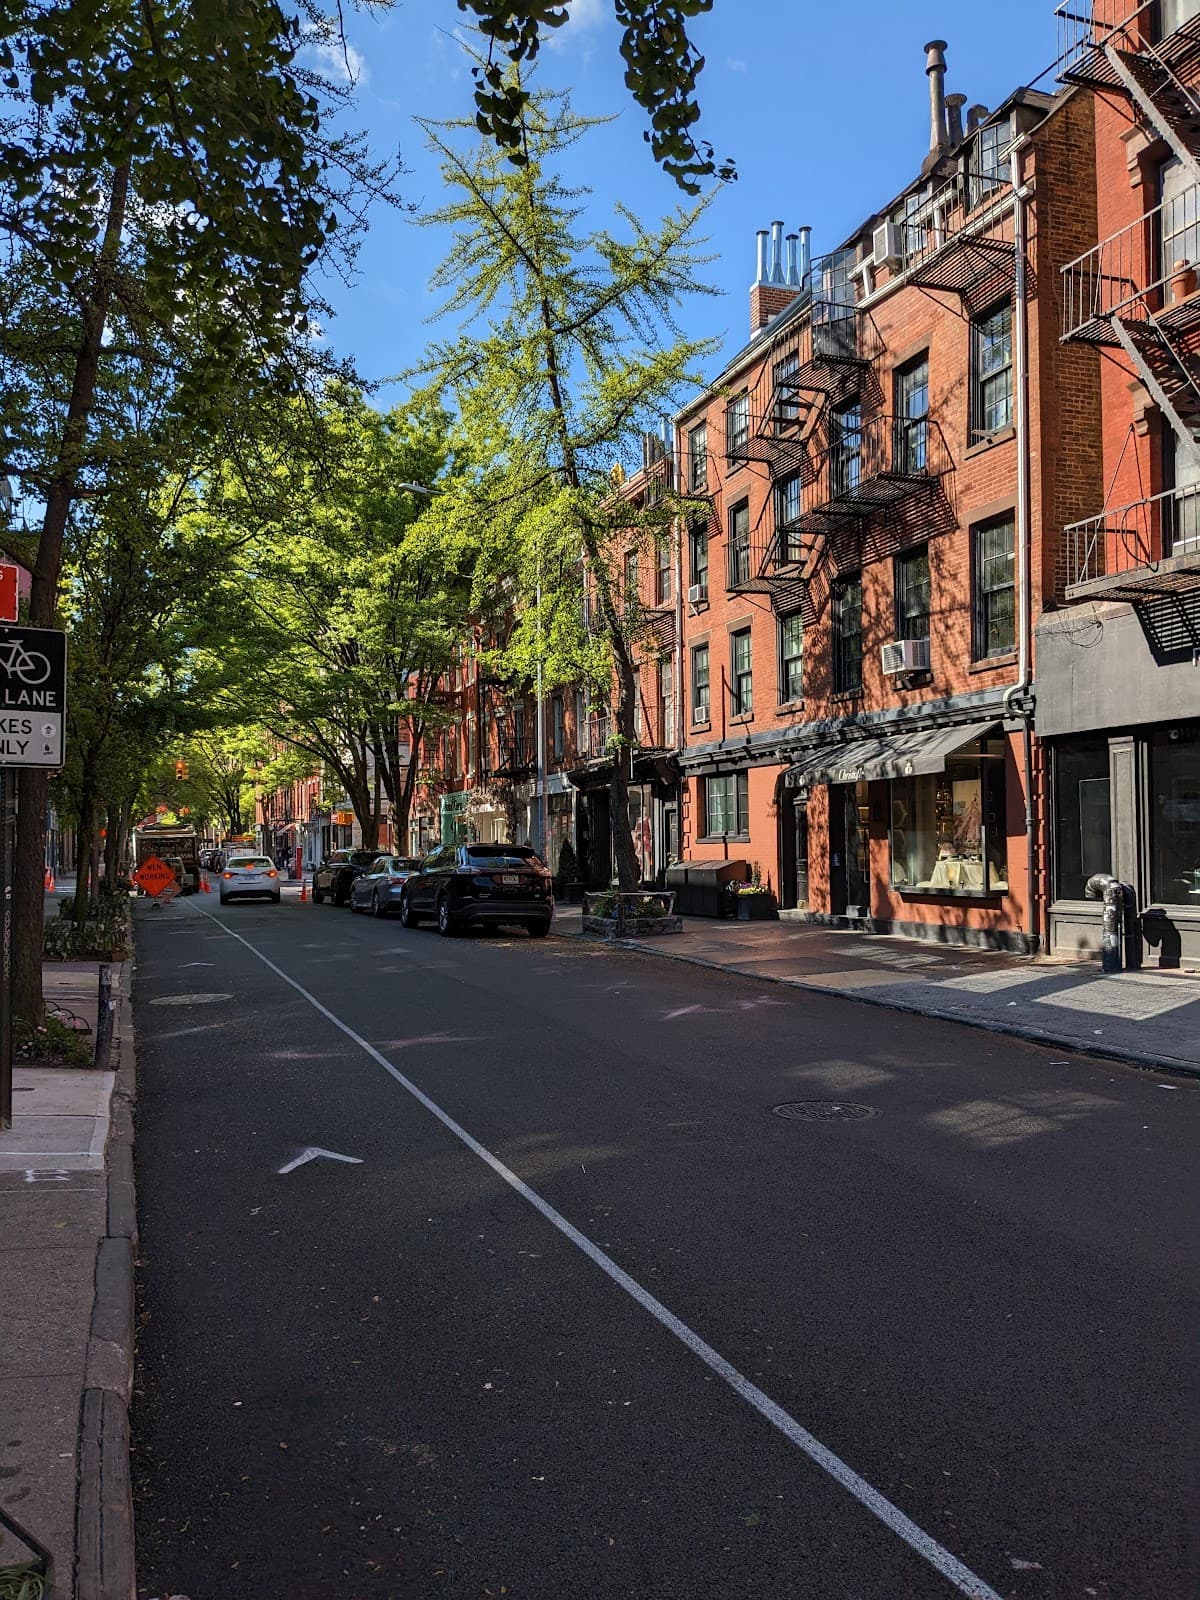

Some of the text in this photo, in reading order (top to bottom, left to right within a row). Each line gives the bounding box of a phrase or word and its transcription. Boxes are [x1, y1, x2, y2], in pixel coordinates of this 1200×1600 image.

[5, 688, 57, 707] LANE
[146, 863, 162, 871] MEN
[139, 872, 169, 881] WORKING
